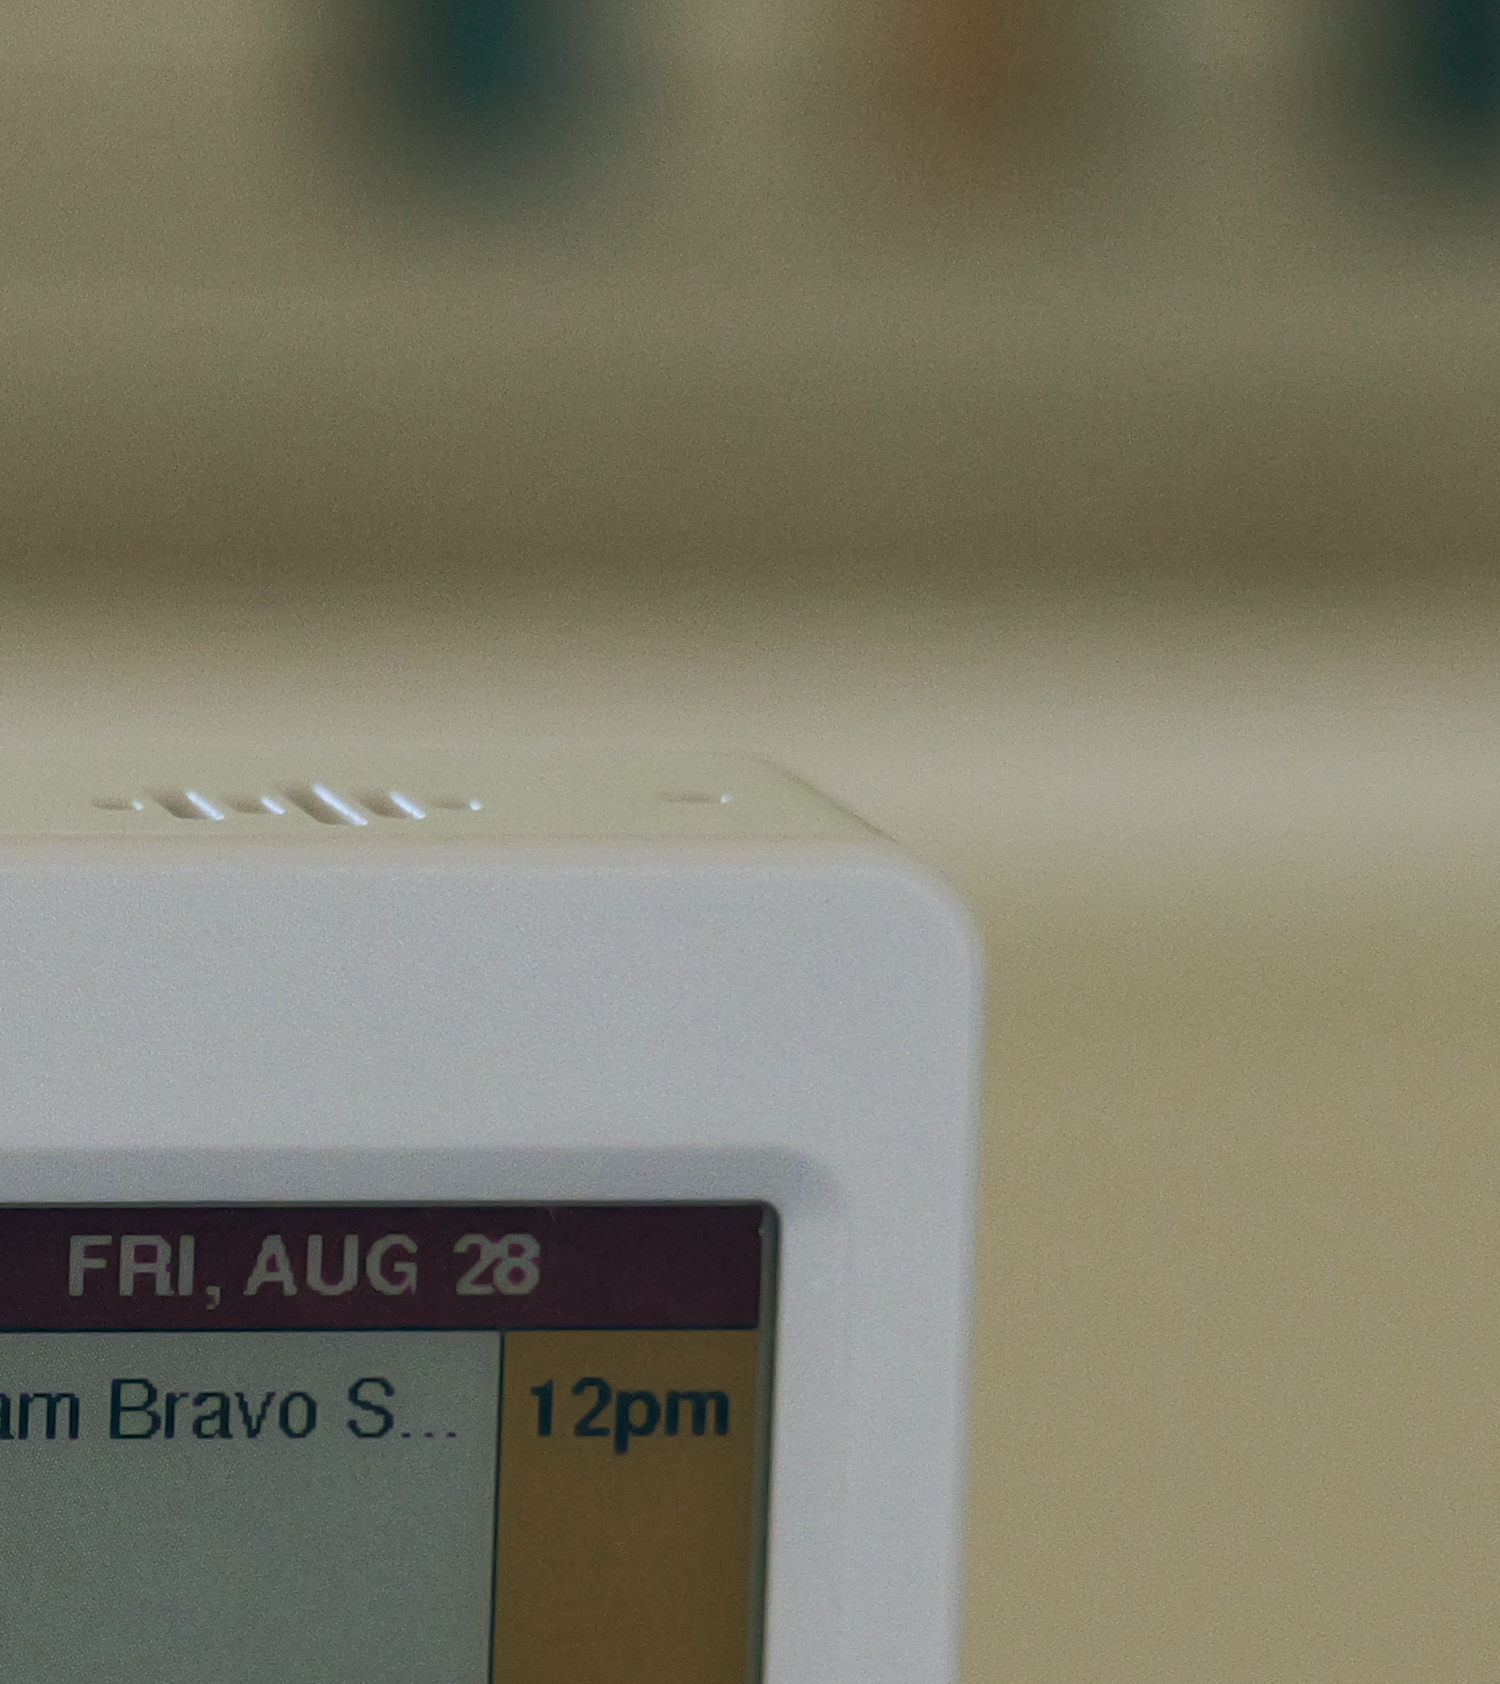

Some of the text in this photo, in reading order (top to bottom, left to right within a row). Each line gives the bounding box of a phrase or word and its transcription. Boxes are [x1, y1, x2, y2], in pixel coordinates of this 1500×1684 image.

[67, 1232, 542, 1310] FRI, AUG 28
[108, 1377, 318, 1441] Bravo
[529, 1376, 731, 1455] 12pm
